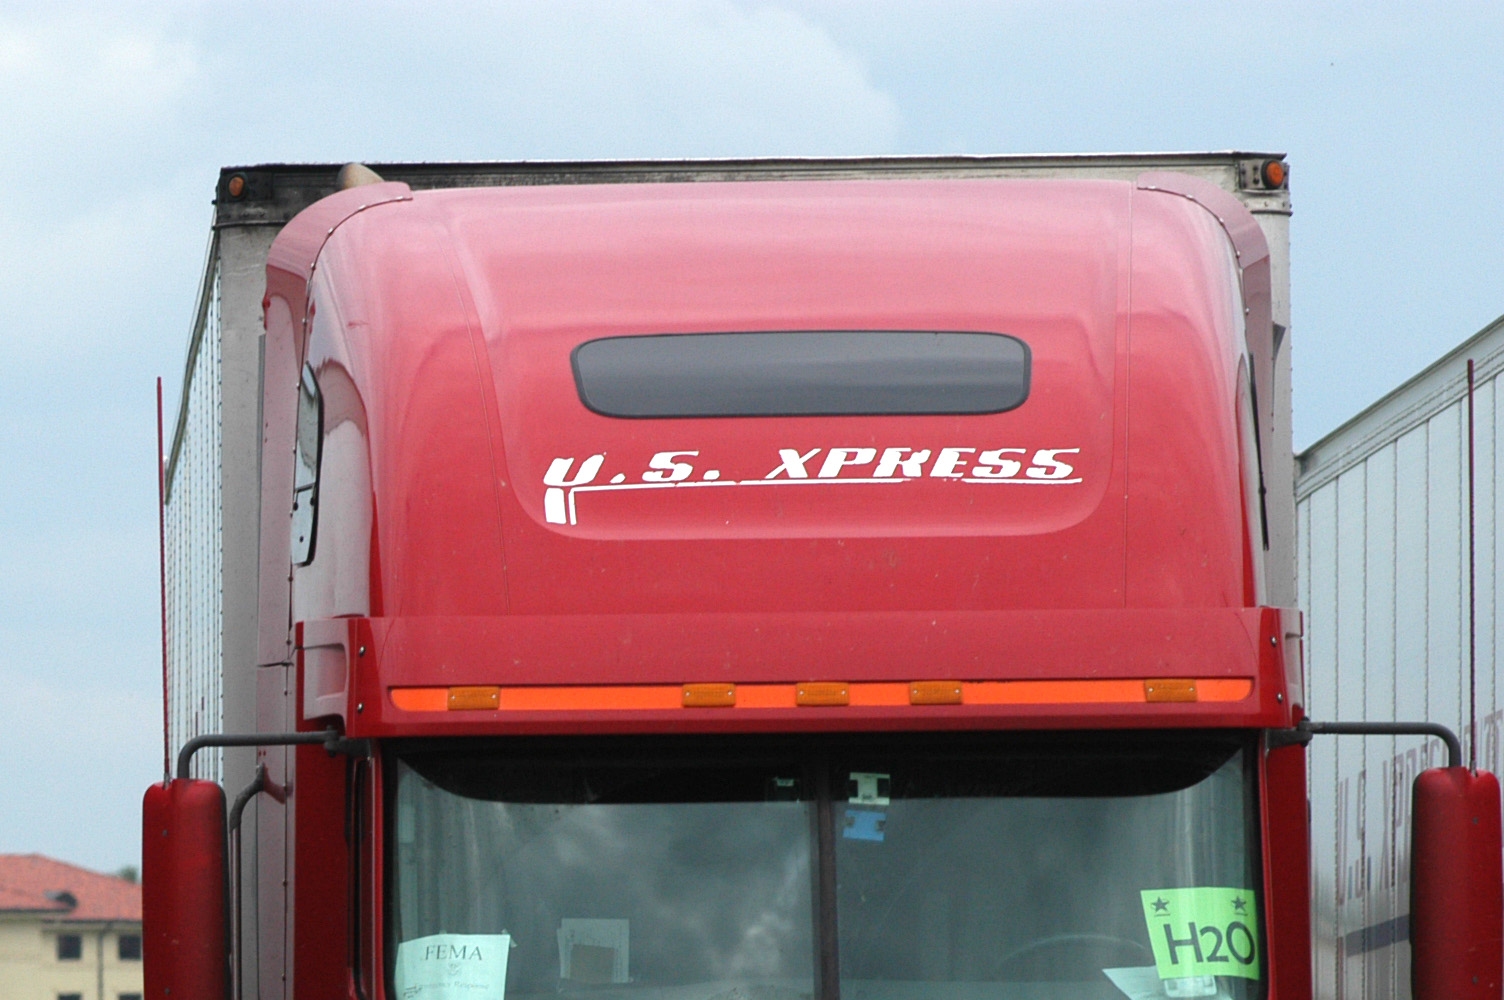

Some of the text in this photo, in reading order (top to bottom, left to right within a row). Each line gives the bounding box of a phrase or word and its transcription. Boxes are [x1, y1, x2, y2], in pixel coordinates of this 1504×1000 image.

[542, 447, 1081, 494] U.S. XPRESS
[425, 944, 483, 960] FEMA
[1163, 920, 1256, 966] H2O
